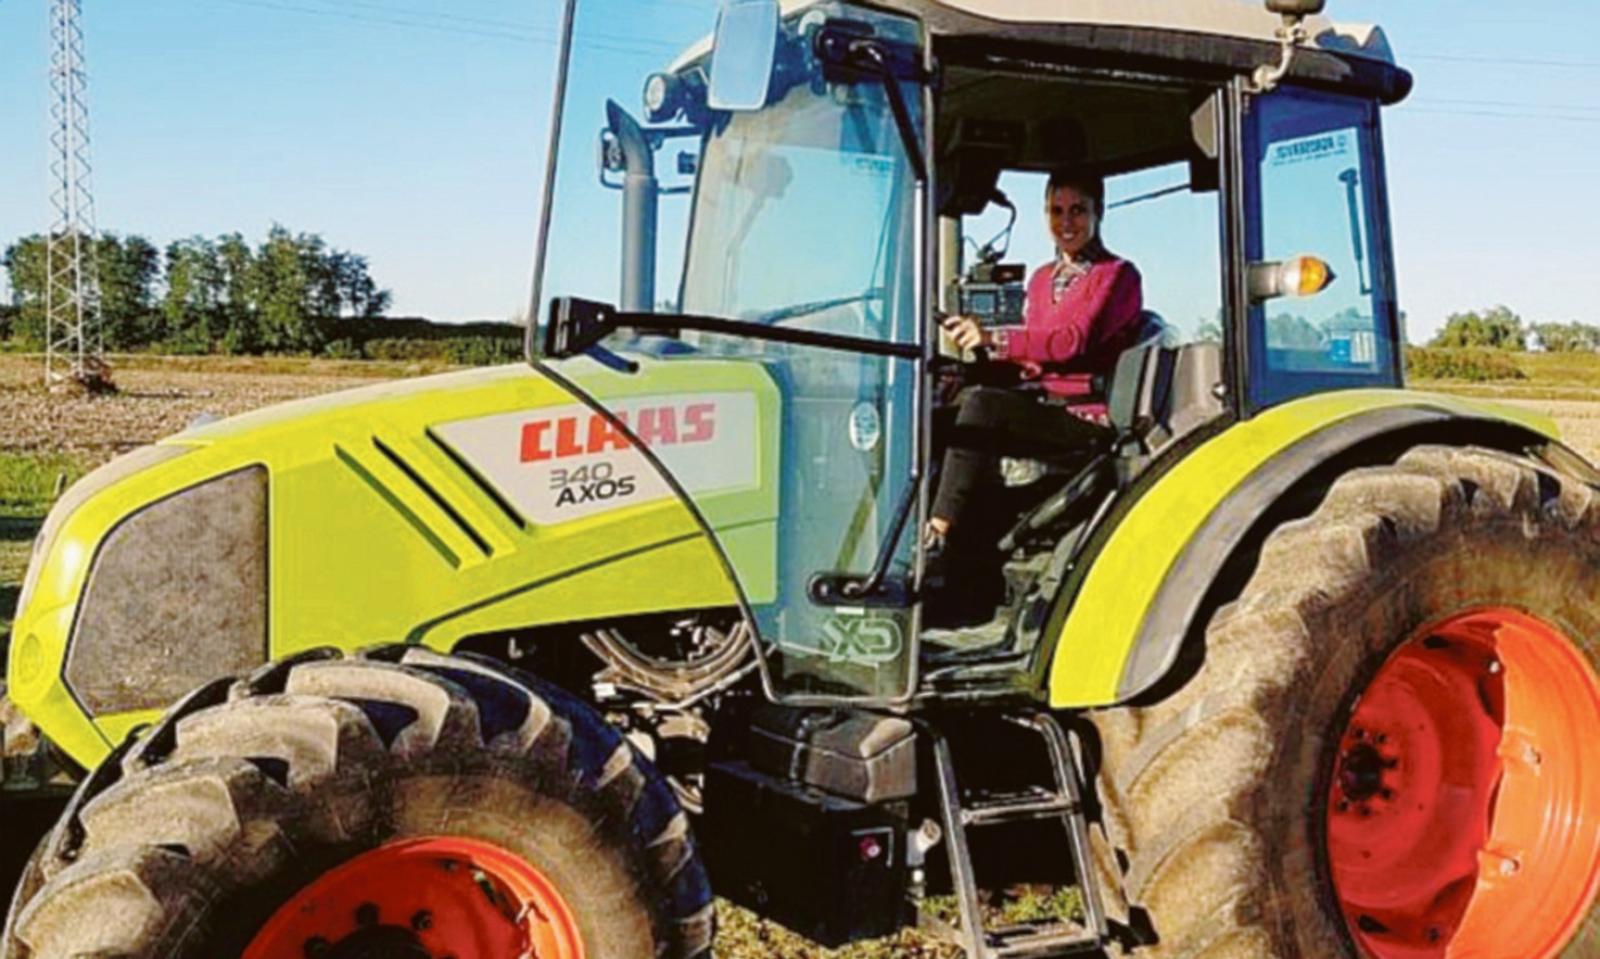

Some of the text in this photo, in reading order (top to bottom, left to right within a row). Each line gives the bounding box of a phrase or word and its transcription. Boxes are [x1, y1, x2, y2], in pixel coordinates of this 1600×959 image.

[520, 403, 715, 463] CLAAS
[549, 461, 613, 489] 340
[555, 475, 635, 507] AXOS
